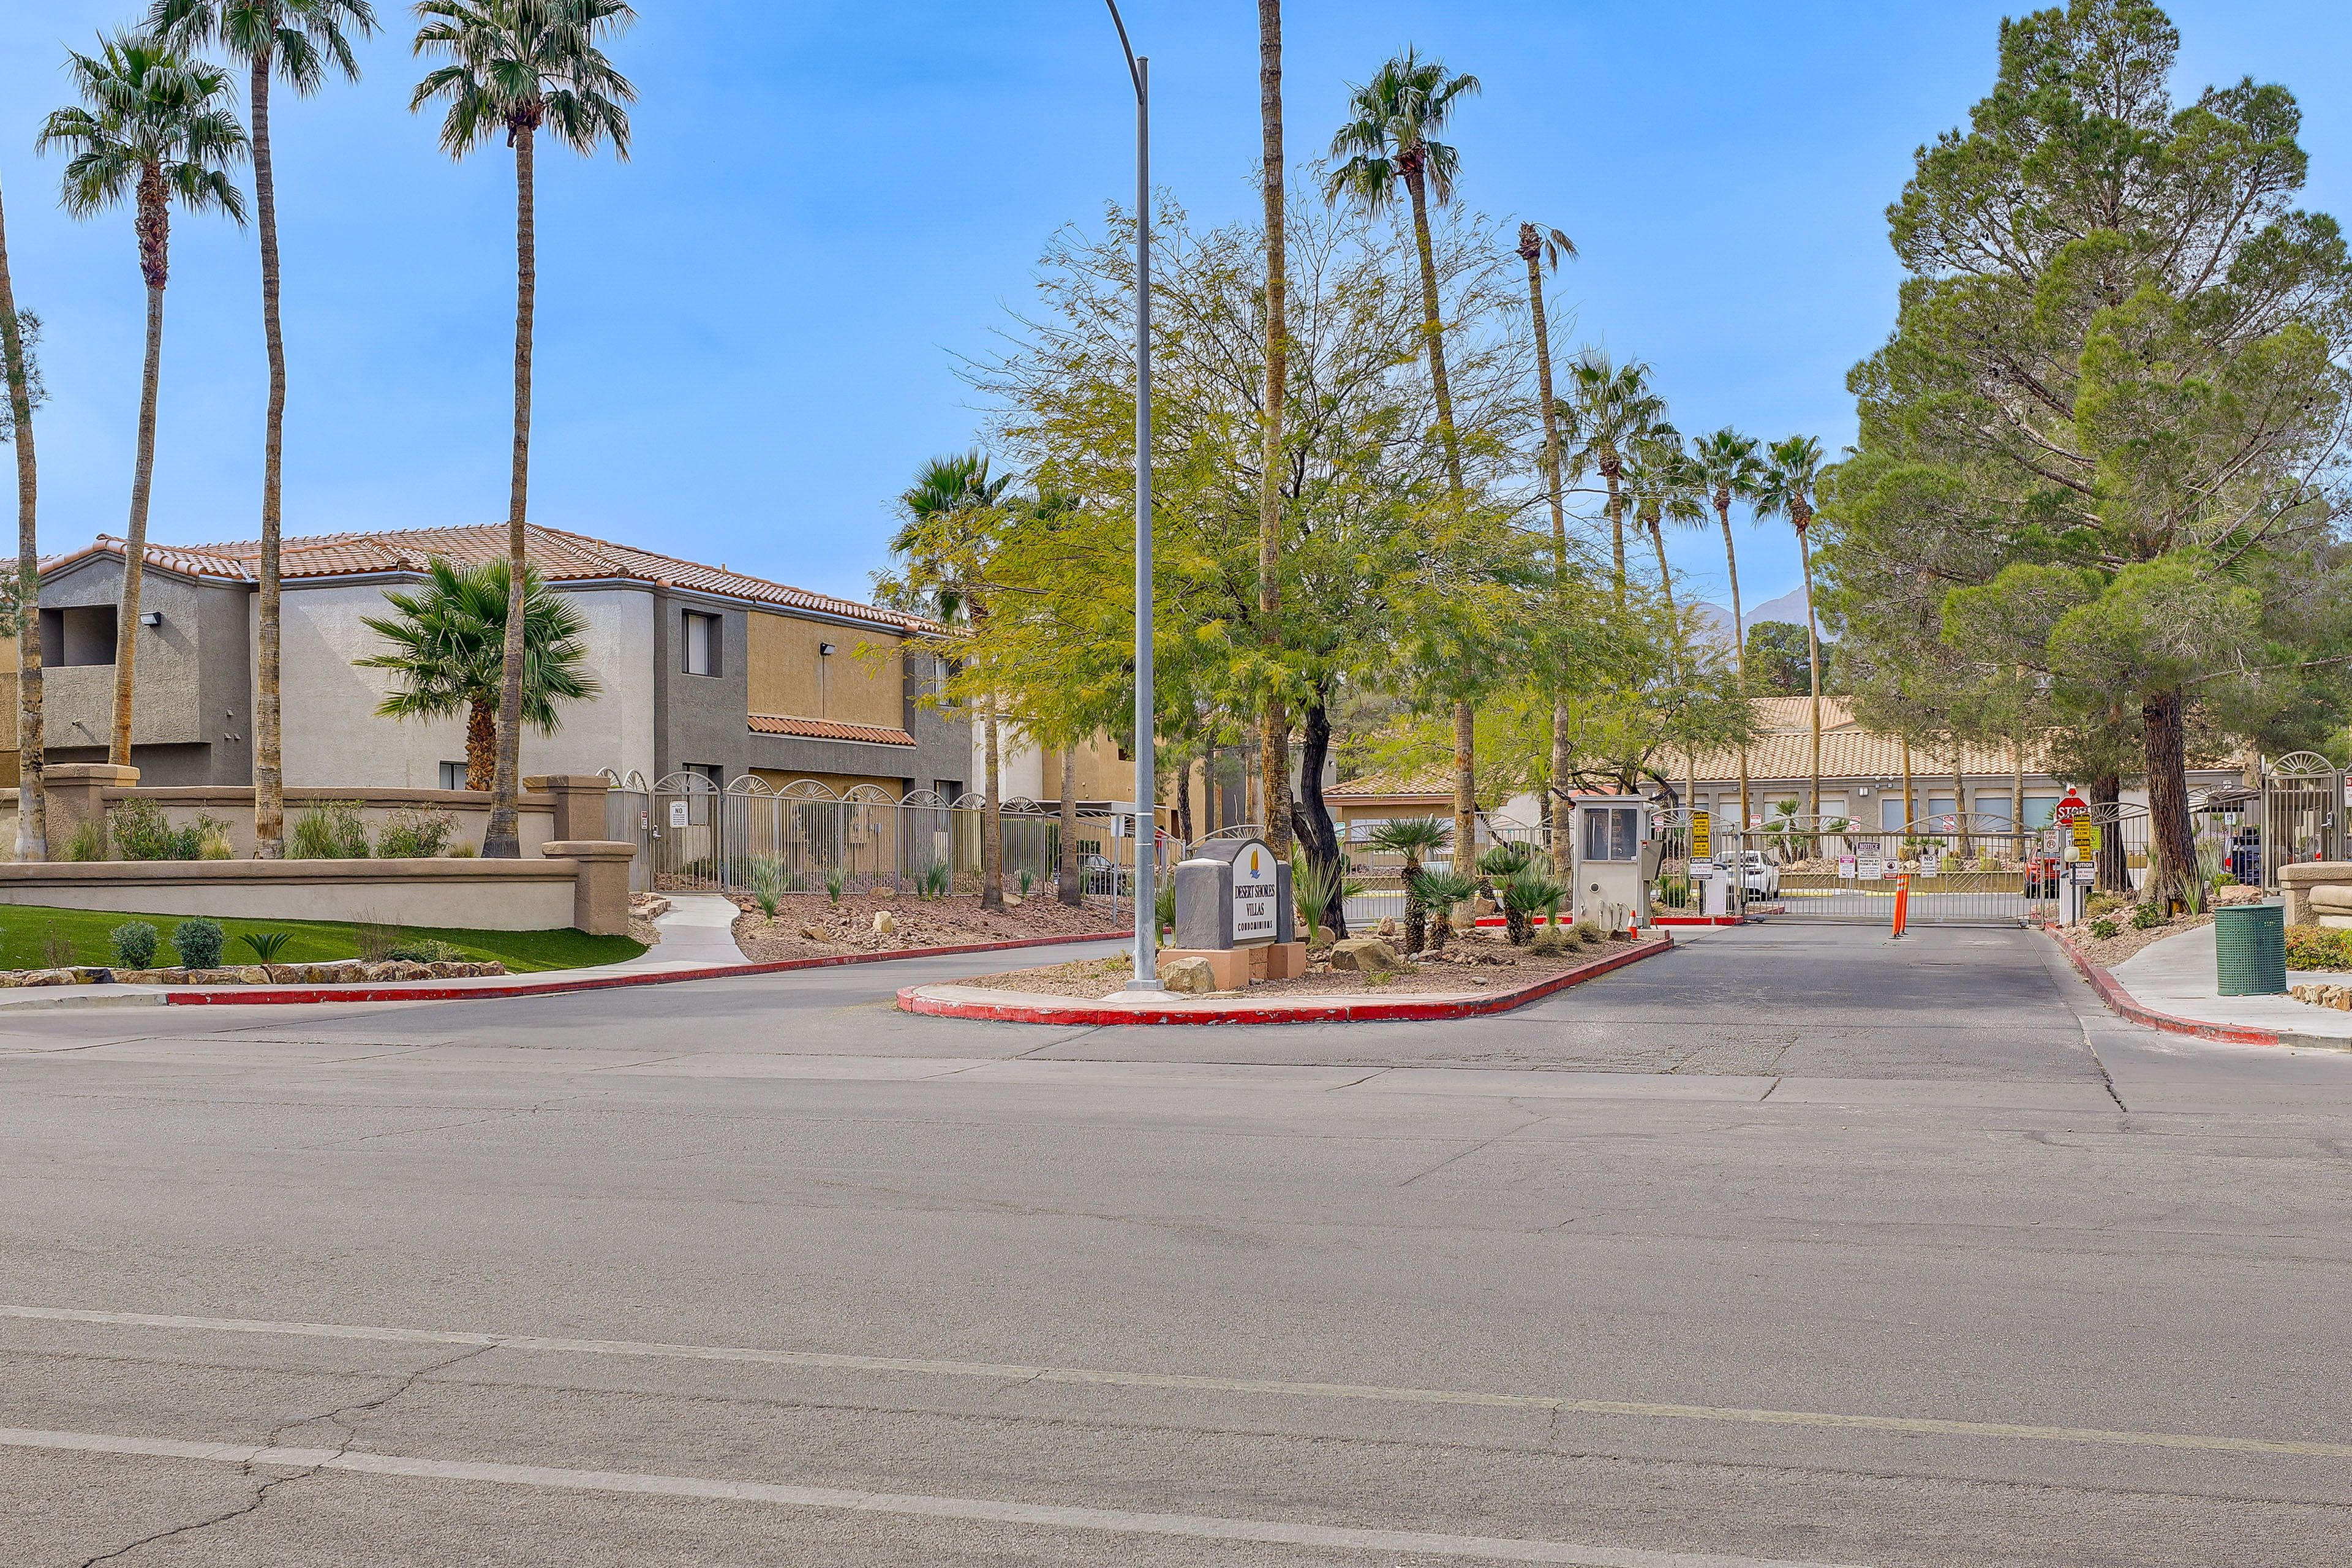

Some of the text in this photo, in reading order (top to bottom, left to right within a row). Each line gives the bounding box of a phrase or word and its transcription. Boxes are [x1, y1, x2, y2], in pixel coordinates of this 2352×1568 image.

[1235, 884, 1275, 899] DESERT SHORES
[1246, 902, 1265, 916] VILLAS
[1238, 920, 1273, 932] CONDOMINIUMS
